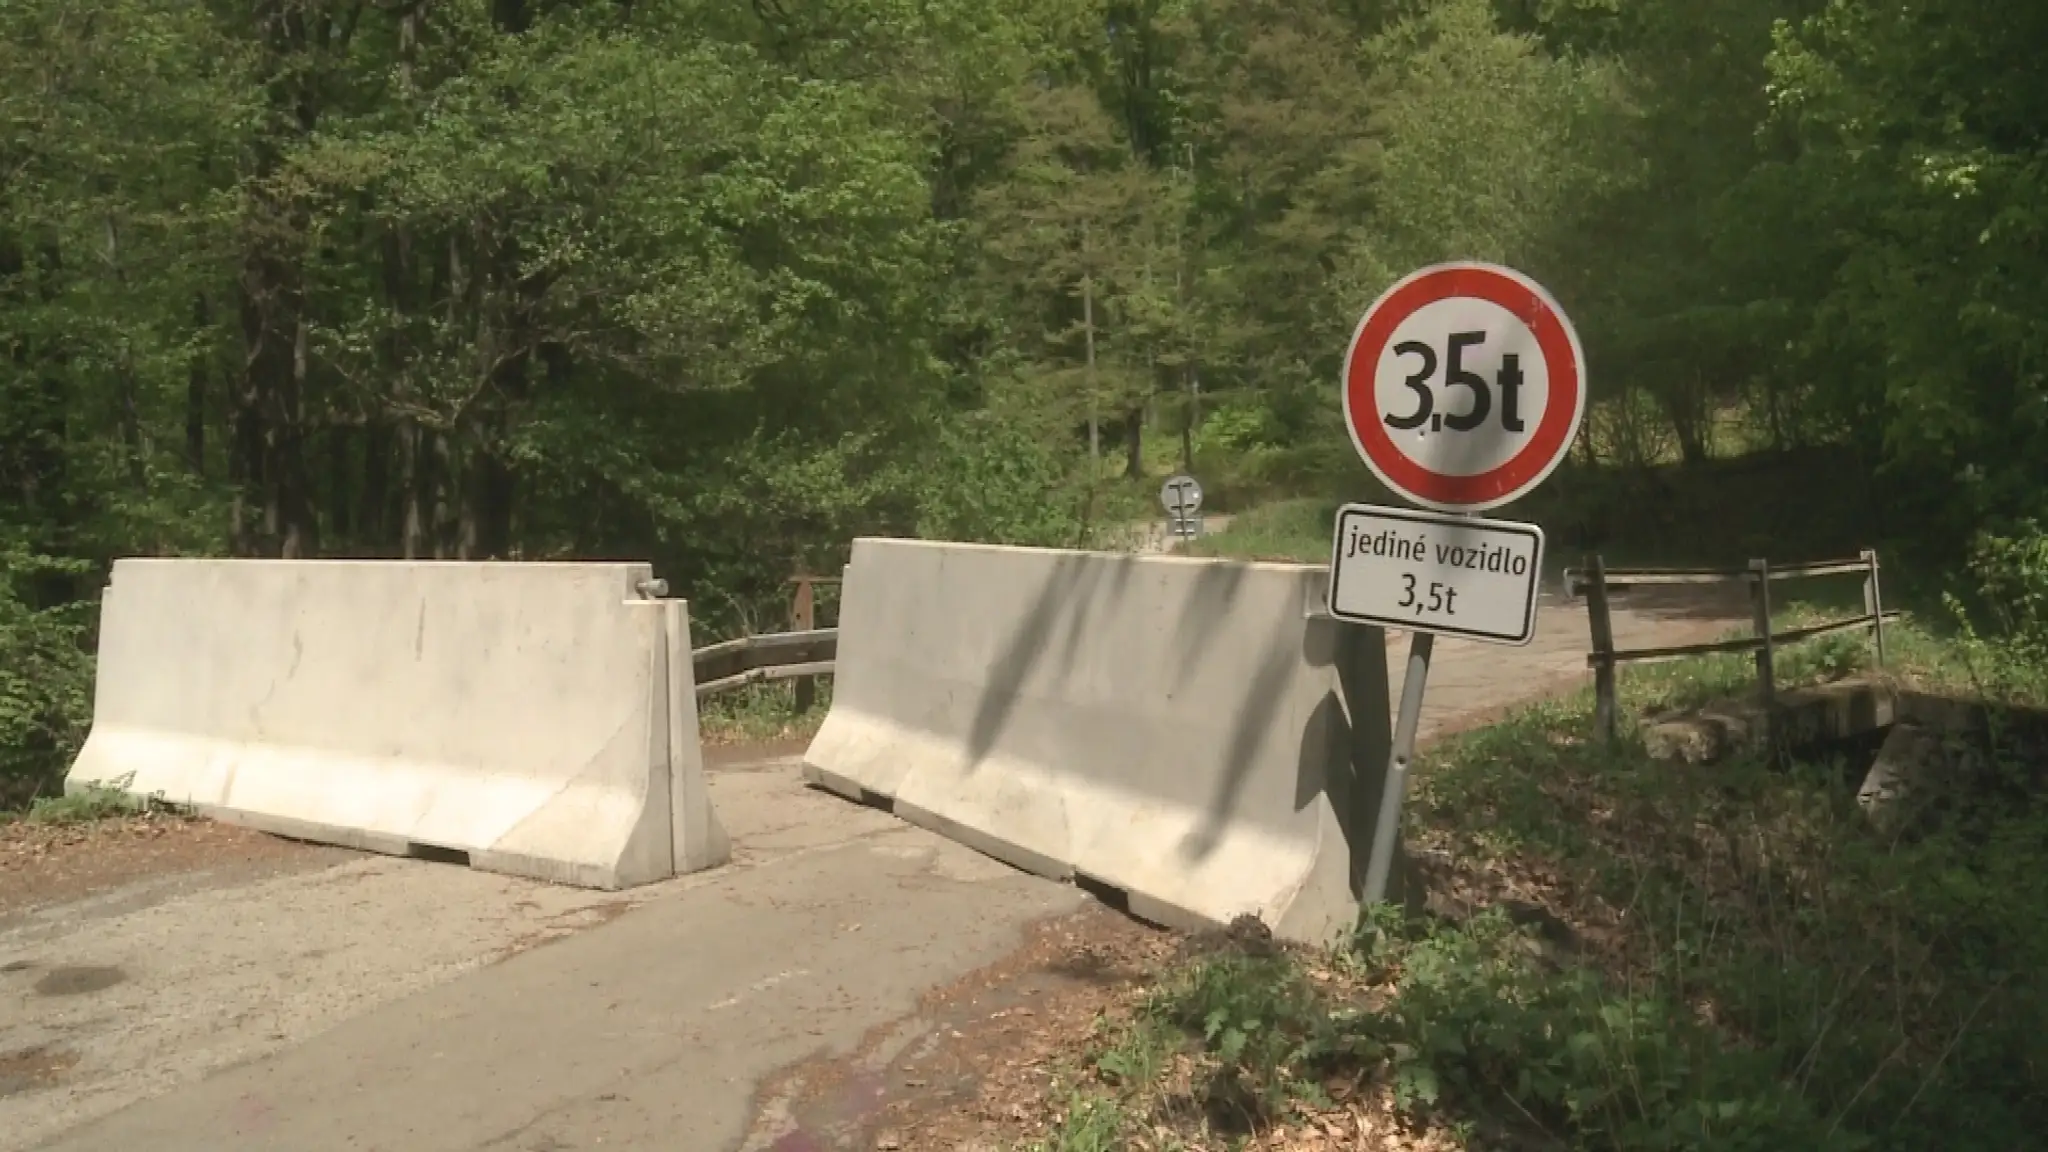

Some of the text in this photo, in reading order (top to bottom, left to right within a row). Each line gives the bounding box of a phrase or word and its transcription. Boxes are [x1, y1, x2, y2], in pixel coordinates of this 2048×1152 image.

[1348, 525, 1527, 575] jediné vozidlo
[1398, 573, 1457, 615] 3,5t
